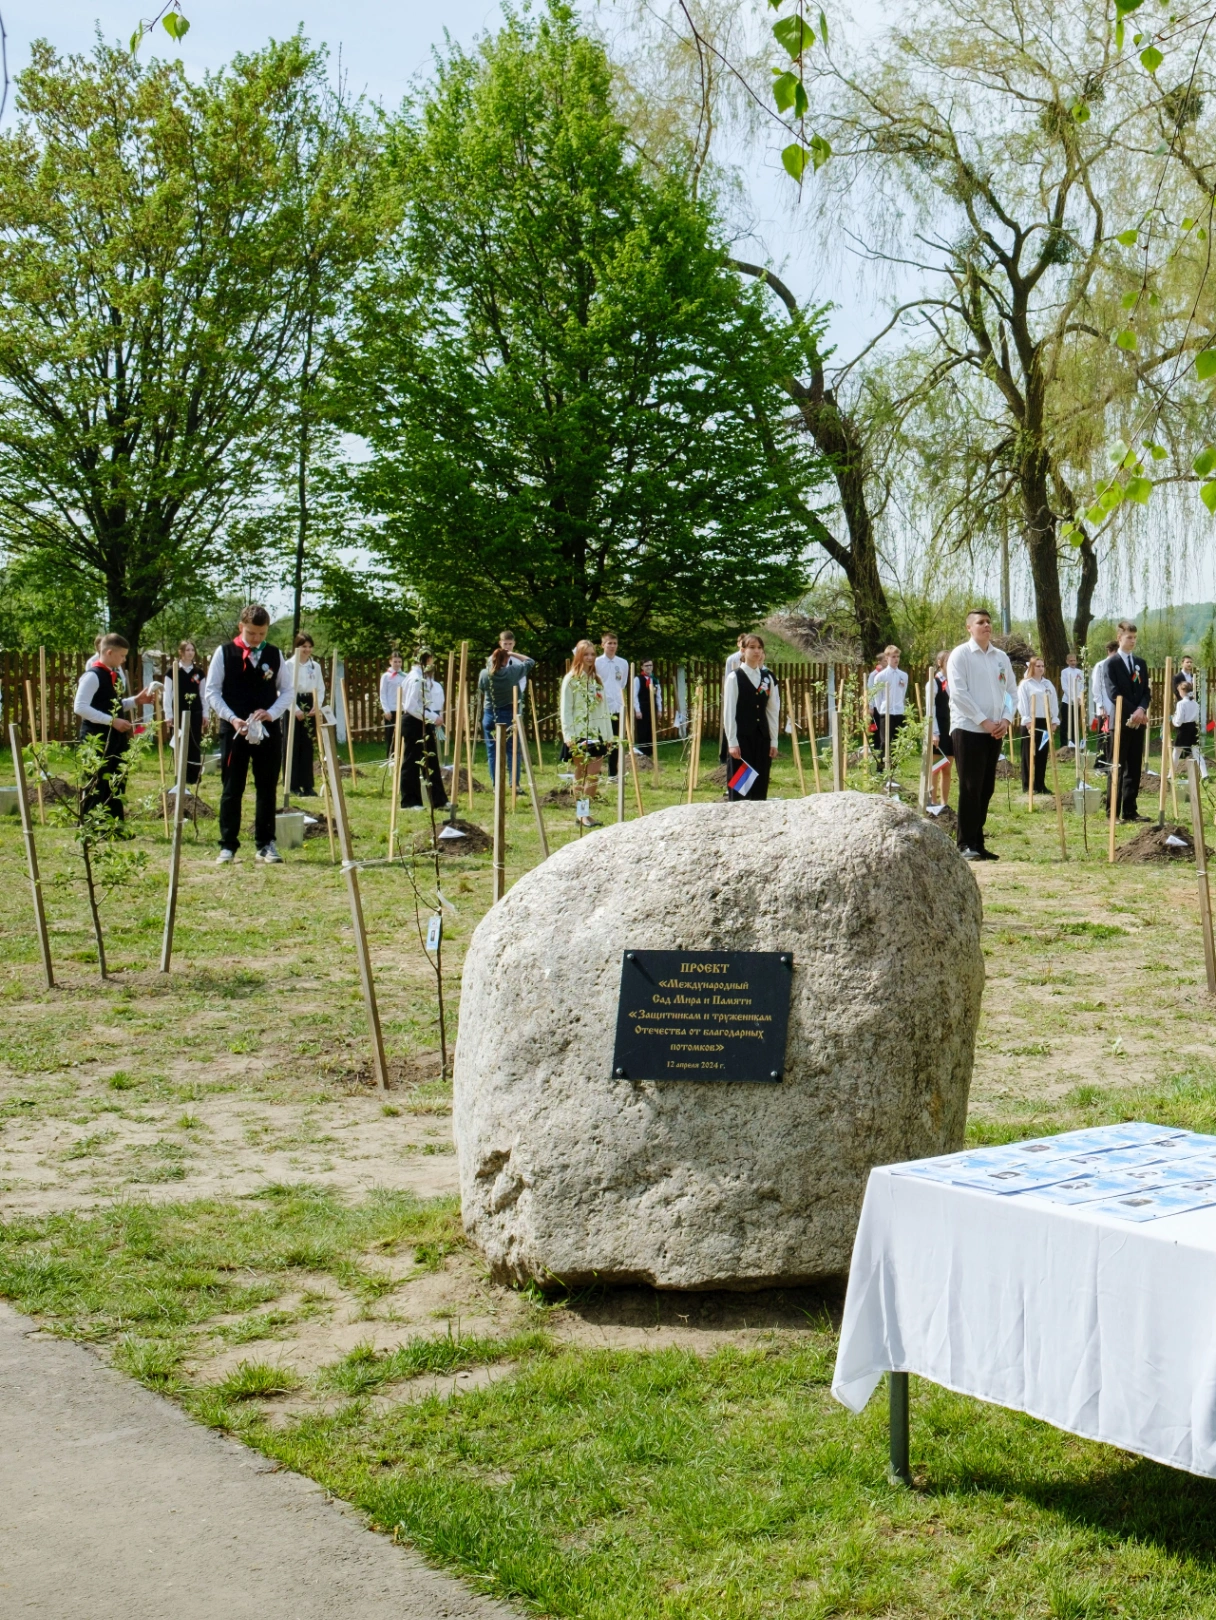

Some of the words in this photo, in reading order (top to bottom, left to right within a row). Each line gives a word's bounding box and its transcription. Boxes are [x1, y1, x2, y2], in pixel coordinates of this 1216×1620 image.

[680, 963, 730, 974] ПРОЕКТ
[659, 979, 748, 991] «Международный
[652, 994, 671, 1004] Сад
[674, 995, 701, 1006] Мира
[713, 995, 752, 1005] Памяти
[629, 1010, 700, 1020] «Защитникам
[712, 1013, 772, 1022] труженикам
[635, 1026, 686, 1035] Отечества
[703, 1028, 764, 1039] благодарных
[670, 1044, 724, 1052] потомков»
